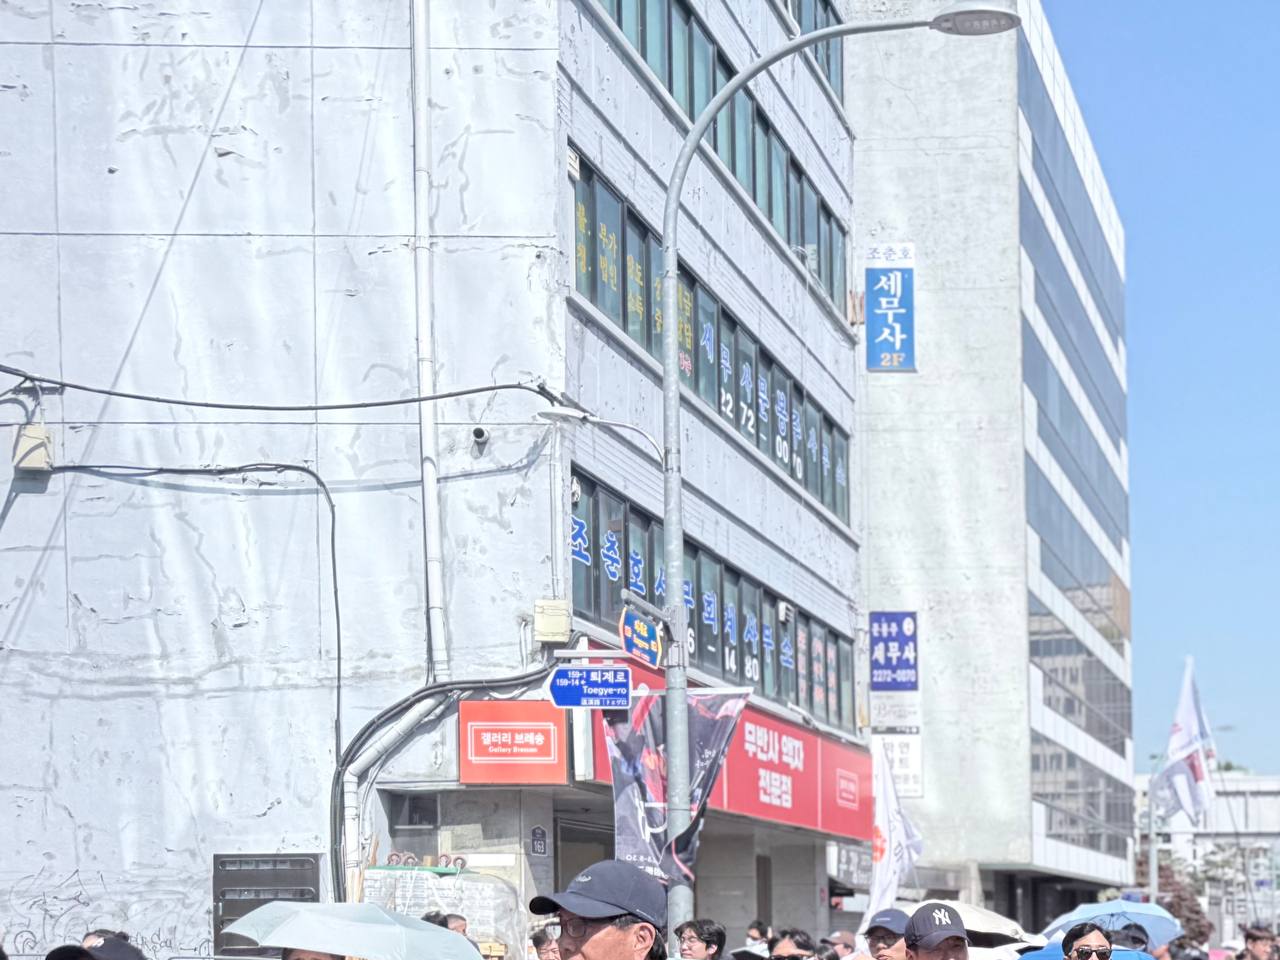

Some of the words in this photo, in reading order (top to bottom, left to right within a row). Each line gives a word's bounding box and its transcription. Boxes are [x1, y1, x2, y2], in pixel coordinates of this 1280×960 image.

[873, 270, 907, 351] 세무사
[880, 352, 906, 367] 2F
[872, 641, 917, 666] 세무사
[590, 671, 627, 684] 퇴계로
[582, 685, 628, 696] Toegye-ro
[480, 731, 513, 746] 갤러리
[514, 731, 545, 746] 브레송
[743, 721, 779, 765] 무반사
[781, 734, 804, 772] 액자
[757, 767, 793, 809] 전문점
[932, 908, 952, 926] NY
